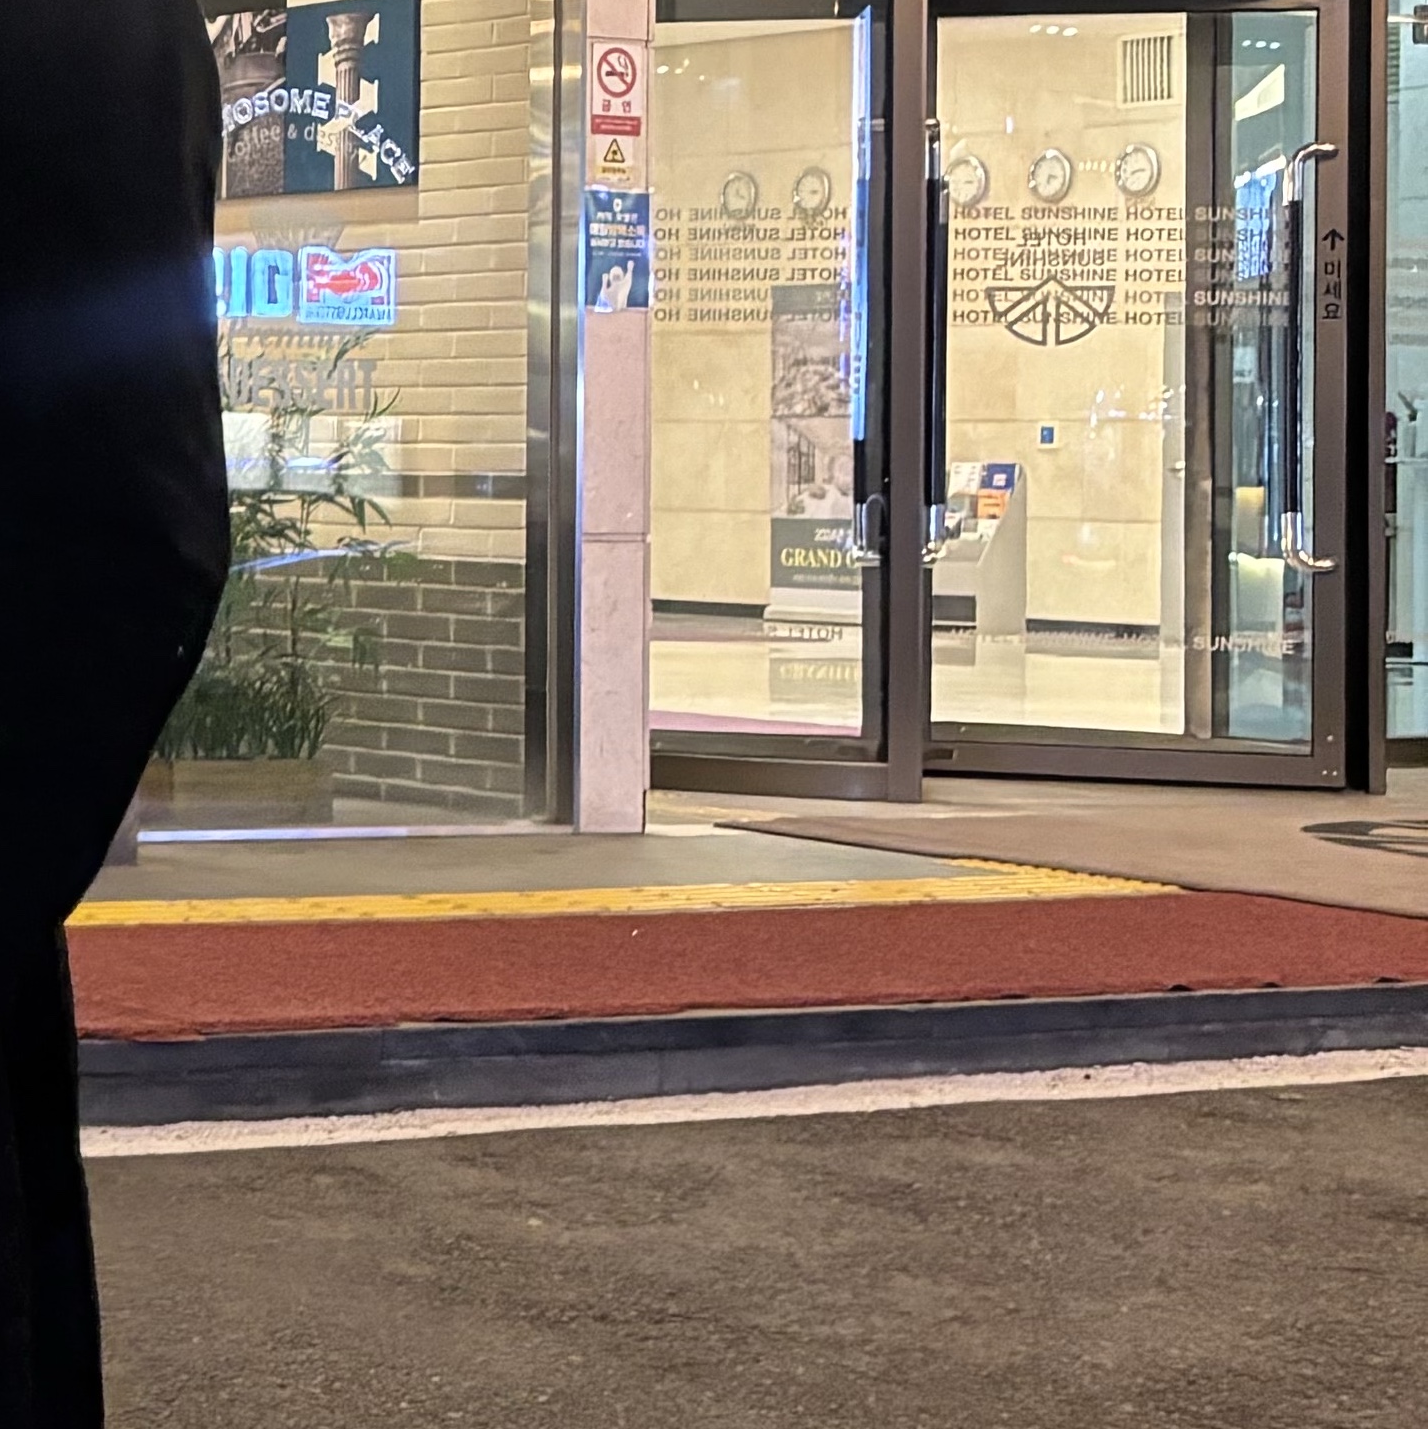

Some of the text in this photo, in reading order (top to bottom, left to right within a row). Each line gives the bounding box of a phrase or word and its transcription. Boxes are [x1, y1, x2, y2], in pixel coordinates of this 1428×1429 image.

[953, 207, 1015, 220] HOTEL
[1021, 207, 1119, 220] SUNSHINE
[1126, 207, 1188, 221] HOTEL
[954, 227, 1016, 241] HOTEL
[1022, 227, 1119, 241] SUNSHINE
[1126, 227, 1187, 242] HOTEL
[1125, 248, 1187, 263] HOTEL
[952, 268, 1014, 282] HOTEL
[1019, 268, 1117, 282] SUNSHINE
[1124, 269, 1186, 283] HOTEL
[1322, 258, 1343, 320] 미세요
[1194, 290, 1290, 306] SUNSHINE
[780, 547, 842, 568] GRAND
[1193, 635, 1295, 655] SUNSHINE
